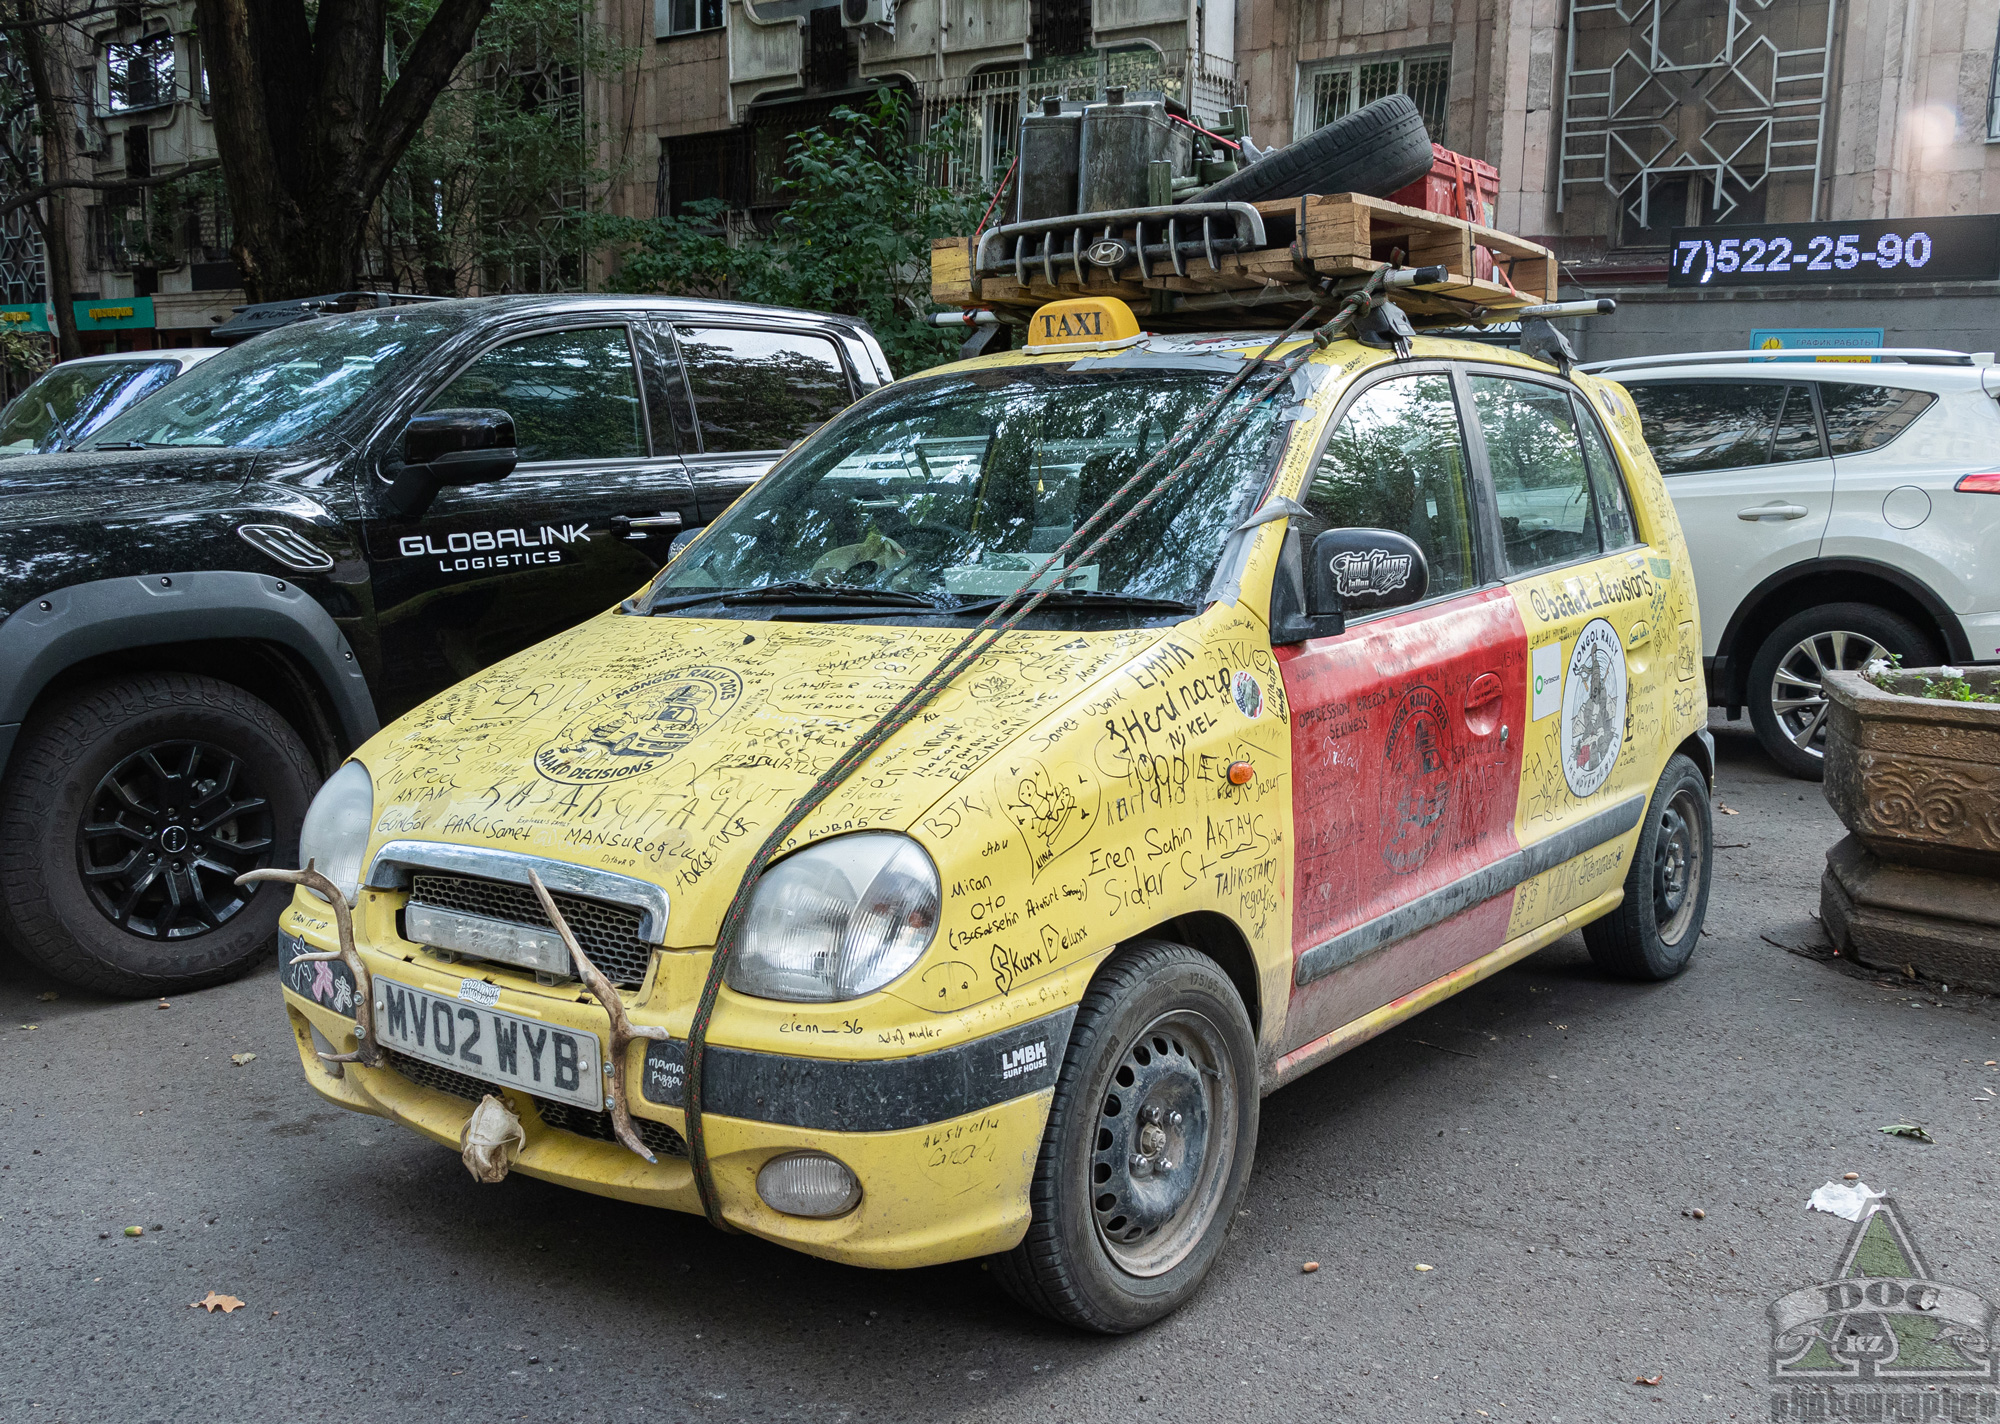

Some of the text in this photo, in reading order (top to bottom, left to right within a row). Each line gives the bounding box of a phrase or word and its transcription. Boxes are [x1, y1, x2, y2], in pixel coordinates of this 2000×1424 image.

[1673, 232, 1932, 283] 7)522-25-90
[1039, 311, 1103, 338] TAXI
[1796, 337, 1874, 347] ГРАФИК РАБОТЫ
[399, 523, 591, 557] GLOBALINK
[439, 551, 561, 572] LOGISTICS
[1530, 570, 1654, 622] @baaad_decisions
[1125, 642, 1194, 690] EMMA
[1572, 629, 1599, 677] MONGOL
[1601, 629, 1619, 657] RALLY
[616, 666, 736, 701] MONGOL RALLY 2025
[1299, 701, 1350, 728] OPPRESSION
[1386, 691, 1449, 761] MONGOL RALLY 2025
[538, 750, 571, 776] BAAAD
[569, 760, 655, 780] DECISIONS
[923, 795, 985, 839] BJK
[1089, 846, 1135, 877] Eren
[951, 875, 992, 898] Miran
[290, 911, 329, 930] TURN IT UP
[386, 984, 580, 1092] MV02 WYB
[649, 1057, 685, 1075] mama
[1002, 1041, 1047, 1070] LMBK
[1003, 1059, 1048, 1080] SURF HOUSE
[651, 1070, 683, 1089] pizza
